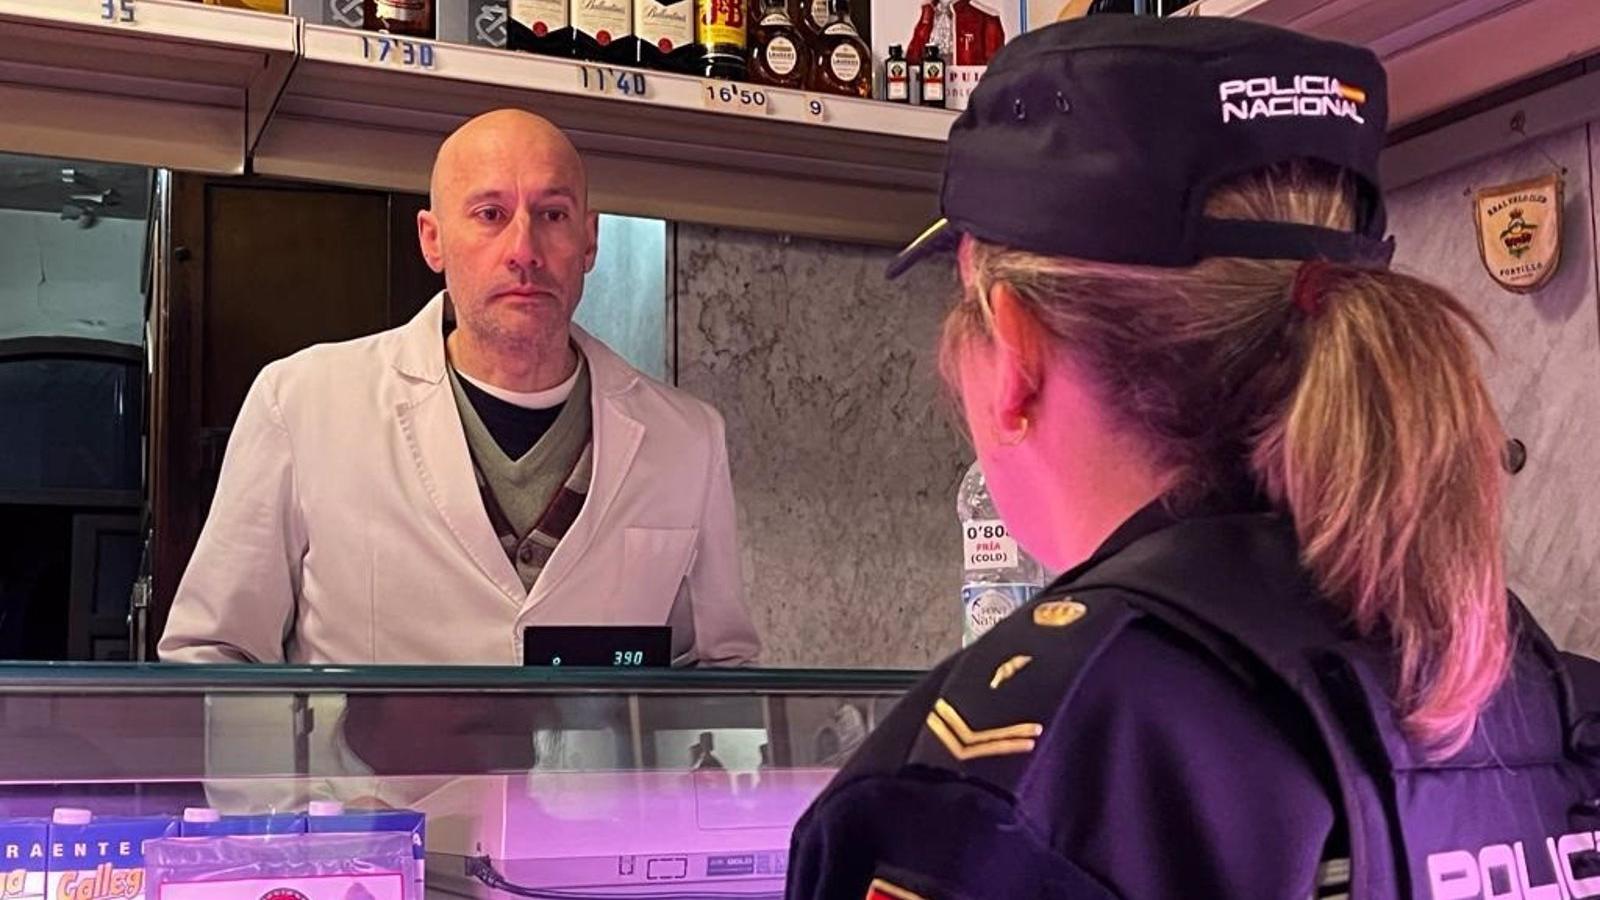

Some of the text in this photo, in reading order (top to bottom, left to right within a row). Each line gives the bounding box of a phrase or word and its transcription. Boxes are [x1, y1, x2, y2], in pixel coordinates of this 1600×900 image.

[363, 37, 433, 66] 17'30
[581, 66, 646, 95] 11'40
[1219, 75, 1344, 101] POLICIA
[707, 84, 766, 105] 16'50
[810, 101, 821, 115] 9
[1222, 95, 1365, 123] NACIONAL
[971, 552, 1008, 563] (COLD)
